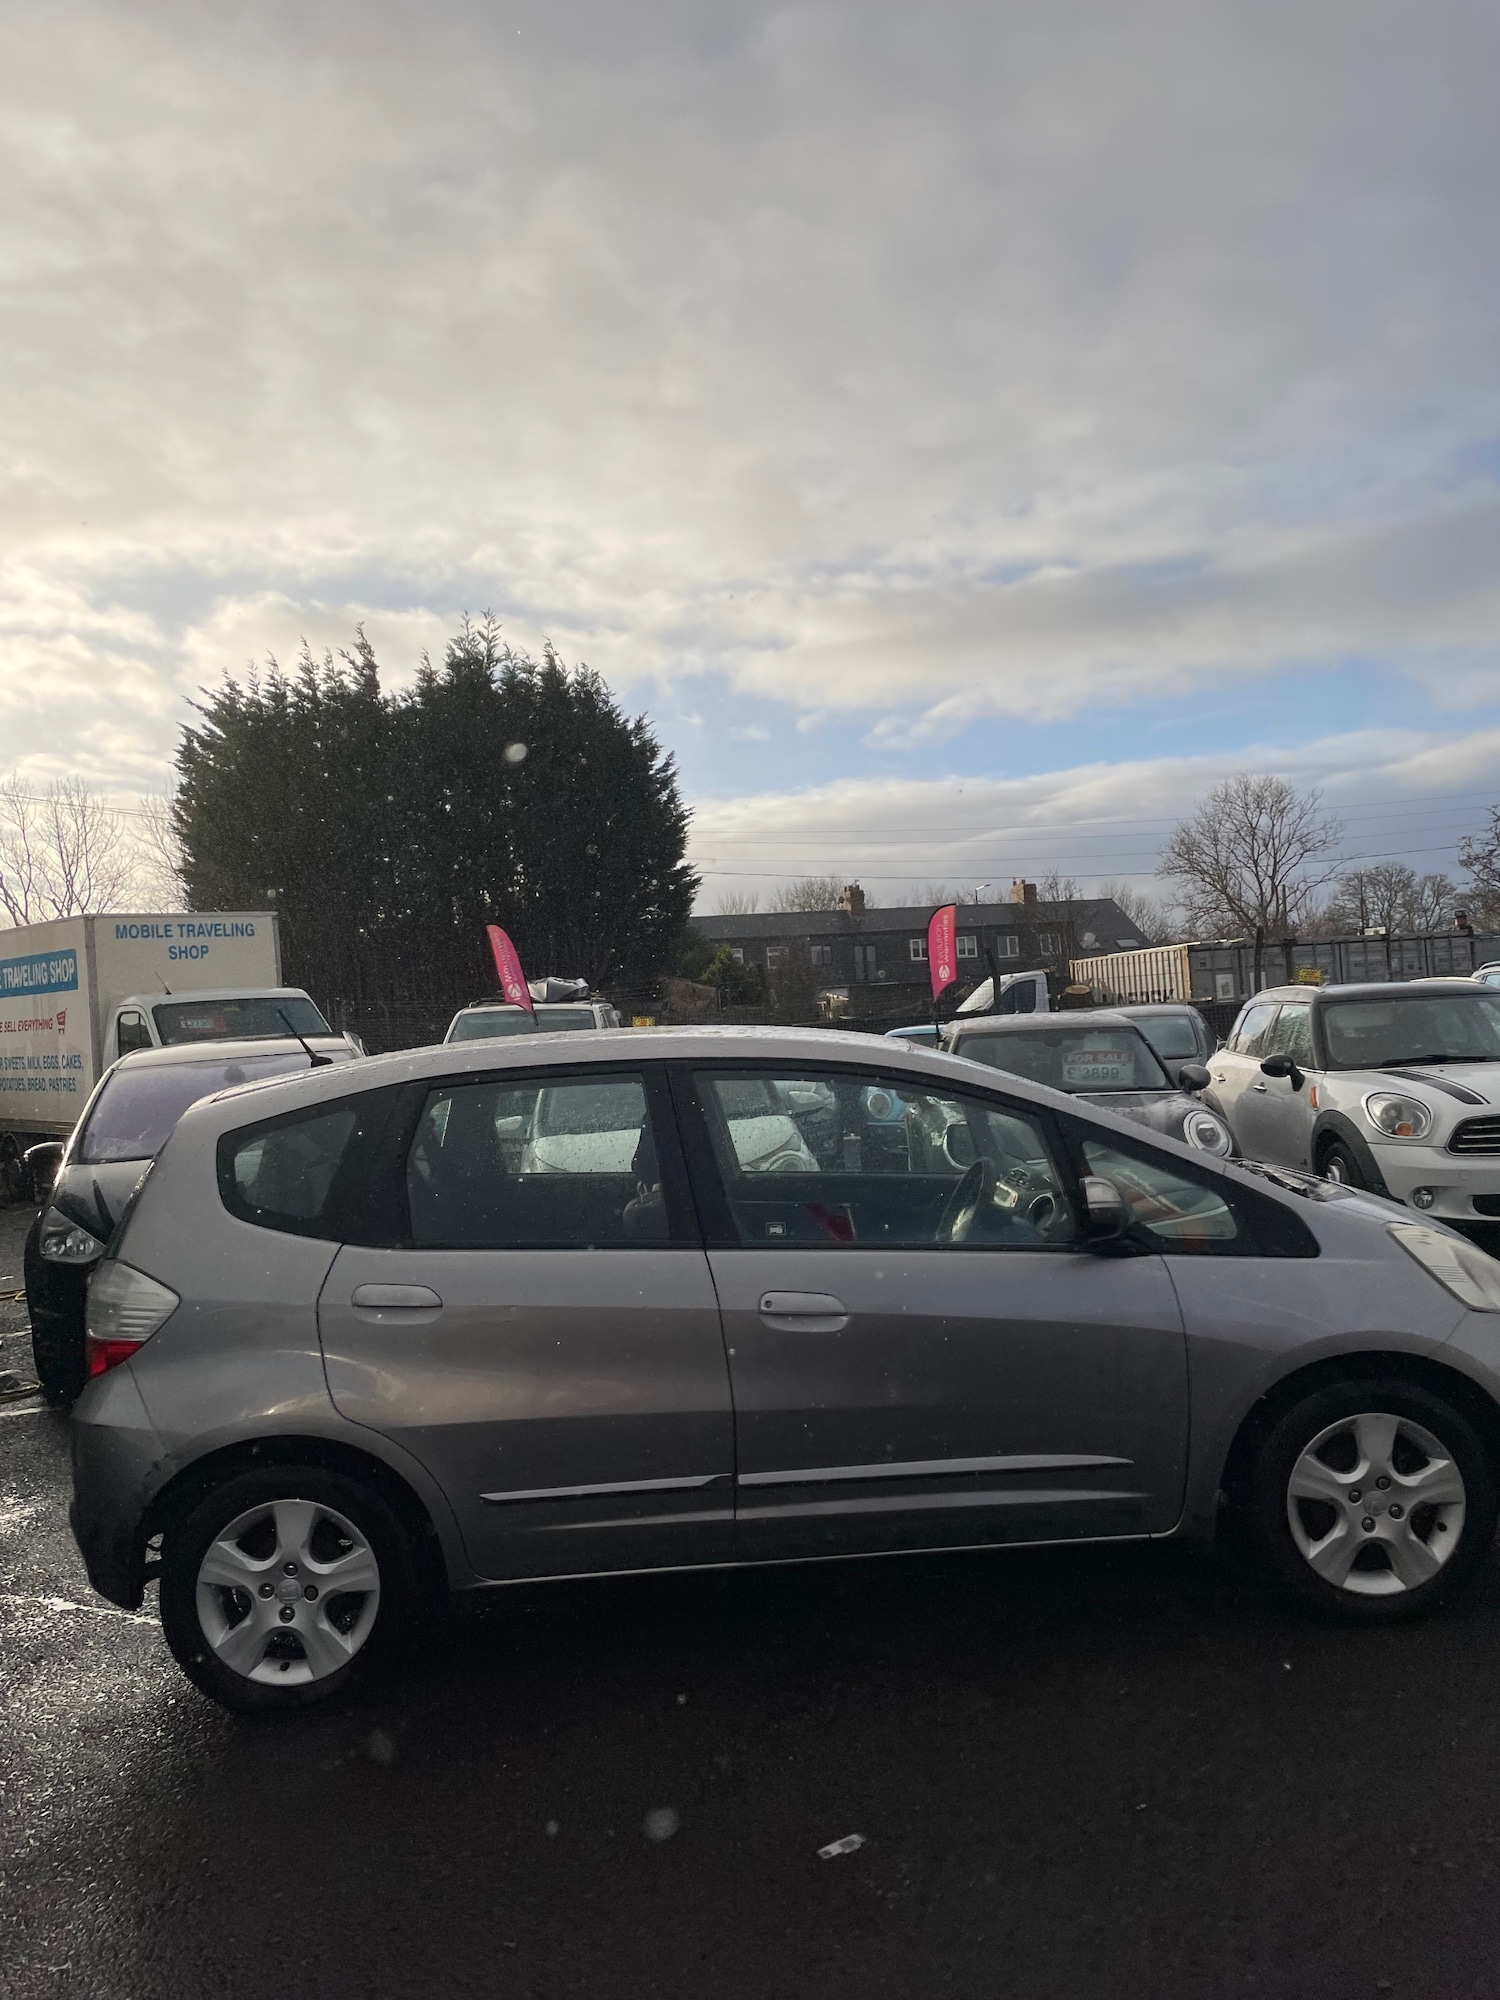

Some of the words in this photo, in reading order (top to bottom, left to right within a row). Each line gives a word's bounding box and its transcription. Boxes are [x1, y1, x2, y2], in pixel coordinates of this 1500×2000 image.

[115, 924, 173, 939] MOBILE
[177, 923, 255, 938] TRAVELING
[168, 945, 209, 960] SHOP
[2, 963, 48, 989] TRAVELING
[49, 958, 75, 984] SHOP
[4, 1021, 17, 1032] SELL
[18, 1018, 53, 1031] EVERYTHING
[43, 1055, 60, 1071] EGGS,
[61, 1054, 84, 1071] CAKES,
[1067, 1053, 1093, 1063] FOR
[1097, 1053, 1129, 1062] SALE
[48, 1077, 77, 1092] PASTRIES
